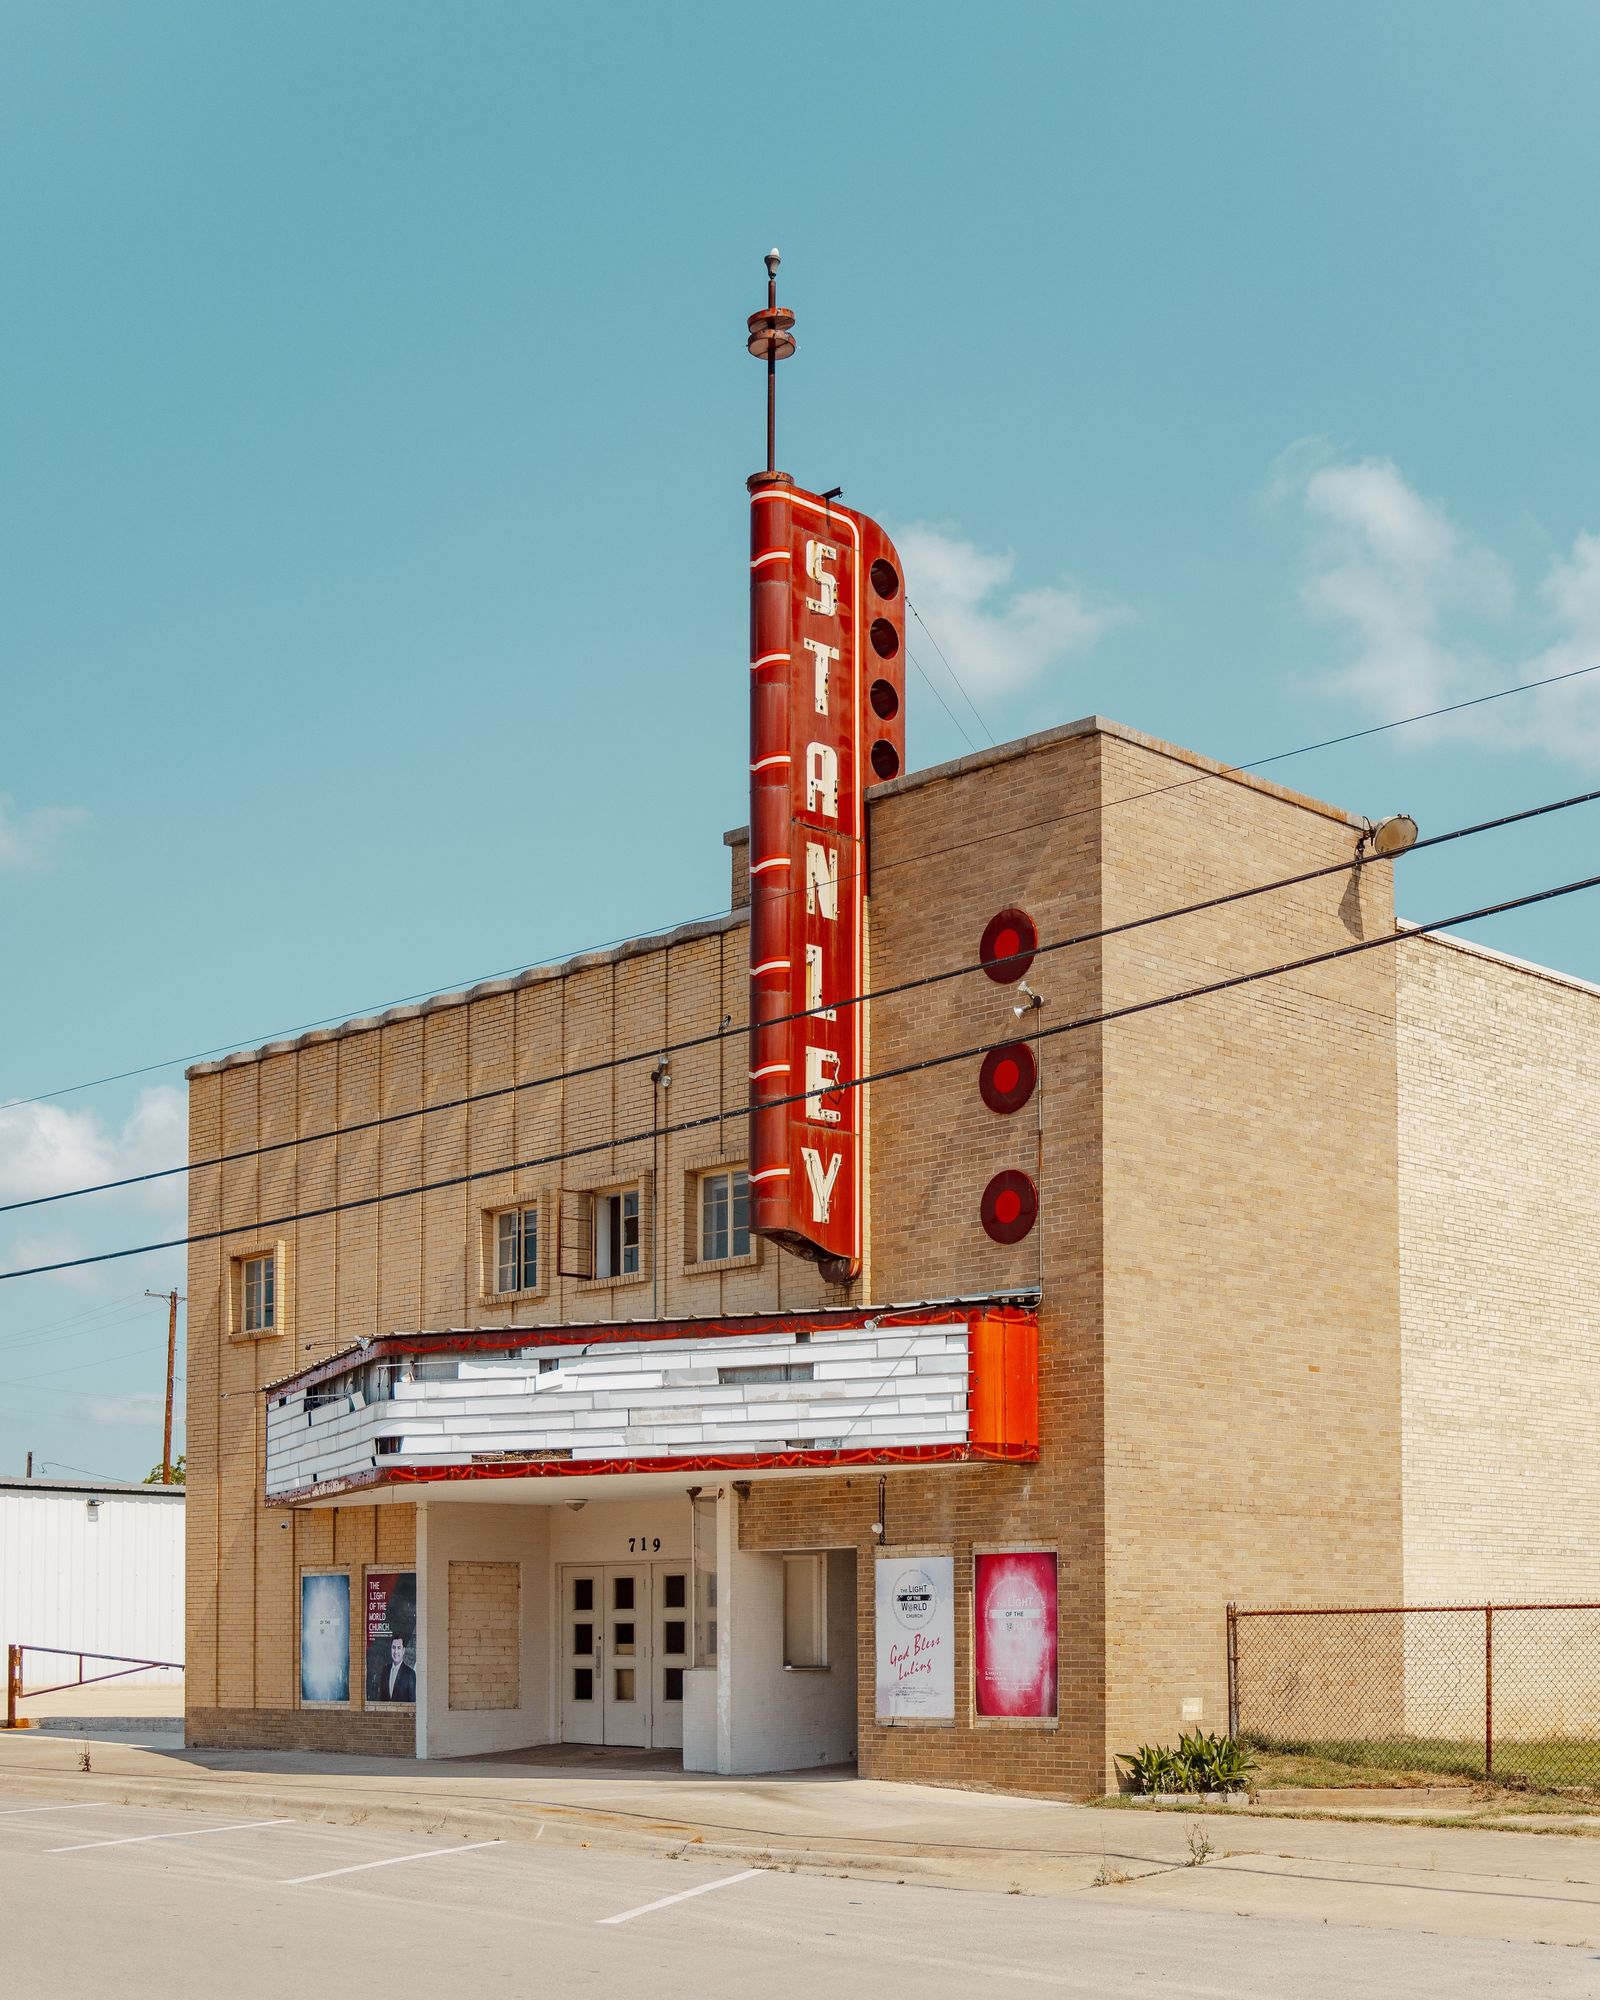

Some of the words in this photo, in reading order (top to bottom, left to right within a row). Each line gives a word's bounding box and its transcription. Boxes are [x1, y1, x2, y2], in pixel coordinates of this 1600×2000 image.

[801, 539, 842, 1224] STANLEY
[628, 1536, 661, 1553] 719
[369, 1581, 380, 1590] THE
[908, 1584, 928, 1593] LIGHT
[370, 1591, 386, 1600] LIGHT
[369, 1602, 376, 1611] OF
[376, 1602, 387, 1611] THE
[368, 1612, 386, 1621] WORLD
[368, 1622, 390, 1631] CHURCH
[890, 1644, 910, 1667] God
[914, 1633, 941, 1656] Bless
[898, 1658, 932, 1681] Luling
